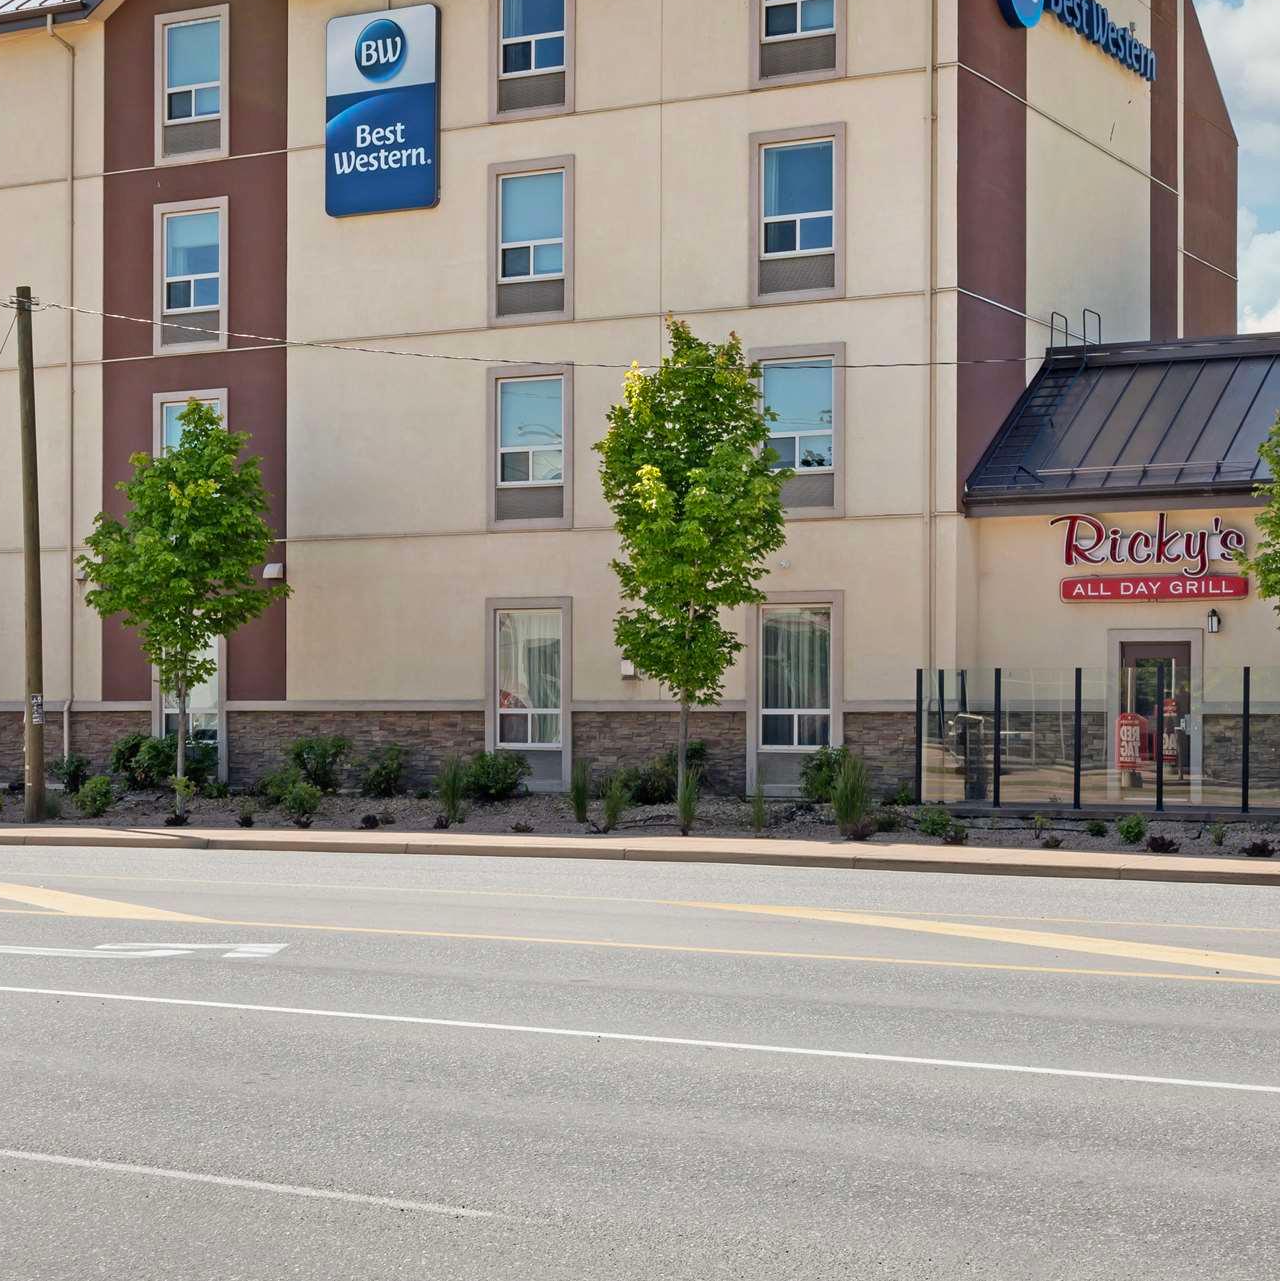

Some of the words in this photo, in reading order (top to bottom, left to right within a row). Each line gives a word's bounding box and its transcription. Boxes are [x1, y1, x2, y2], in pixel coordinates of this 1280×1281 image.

[361, 36, 402, 66] BW
[1092, 0, 1158, 81] Western
[356, 122, 406, 148] Best
[1049, 512, 1245, 577] Ricky's
[1072, 583, 1112, 596] ALL
[1120, 582, 1161, 595] DAY
[1170, 580, 1234, 594] GRILL
